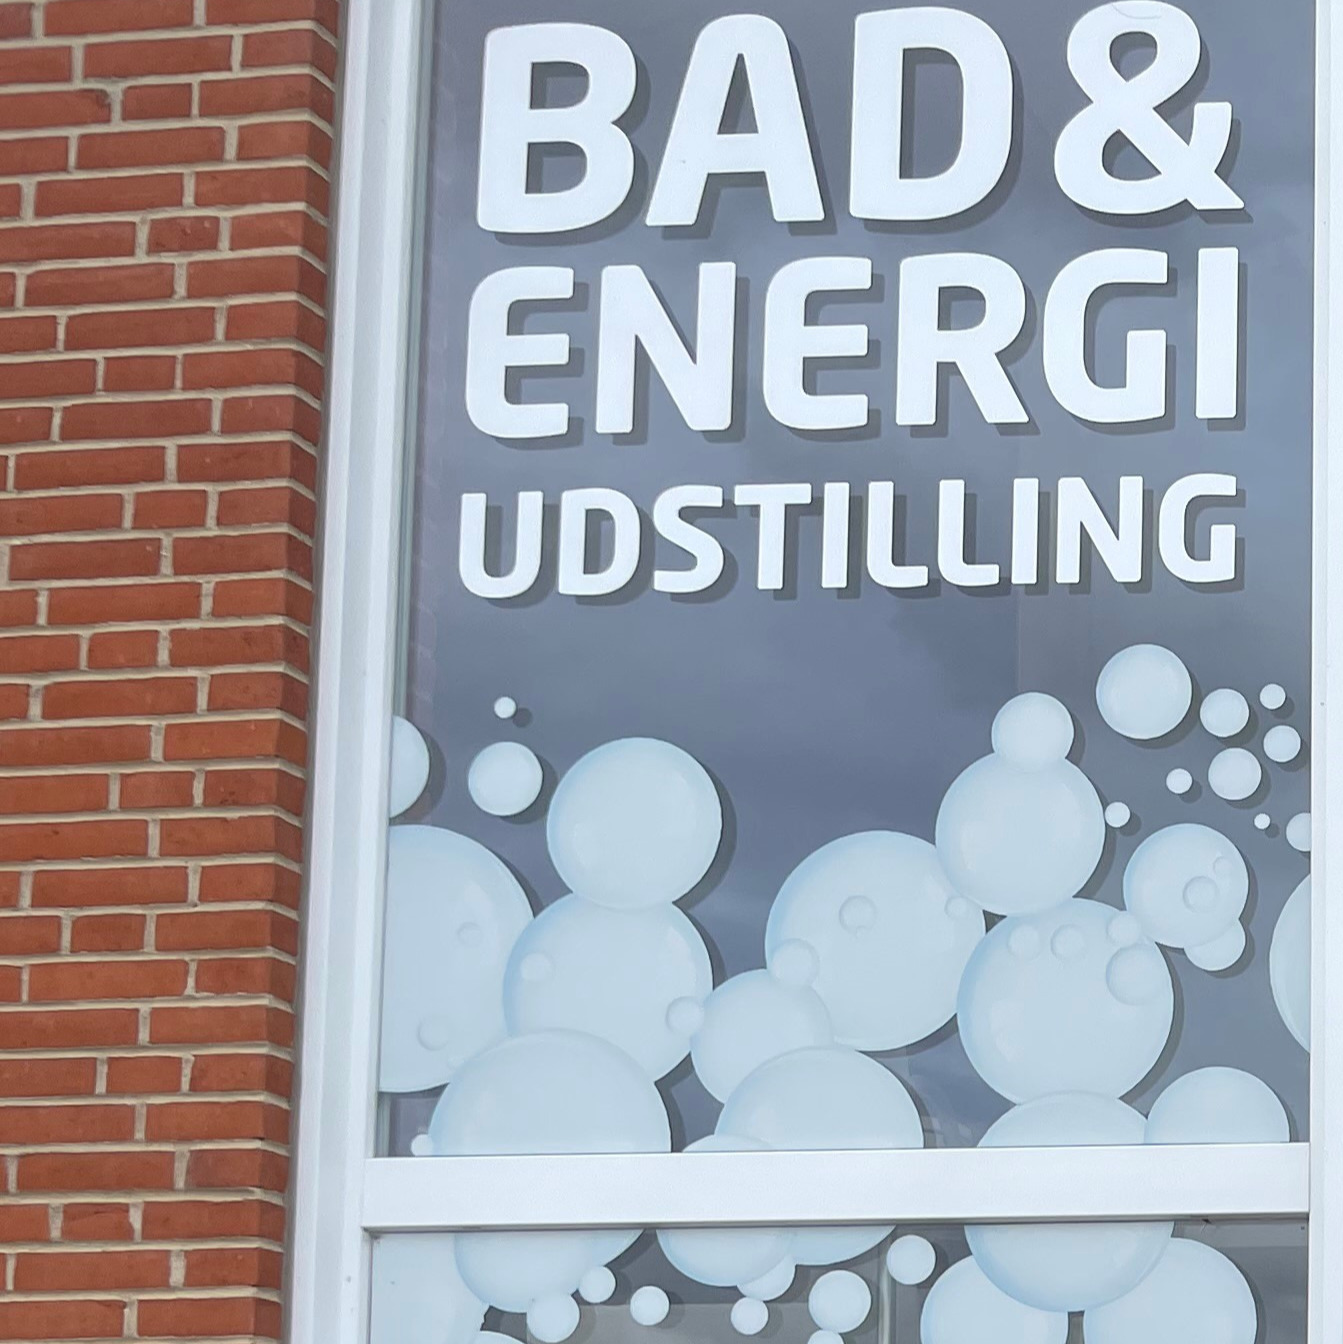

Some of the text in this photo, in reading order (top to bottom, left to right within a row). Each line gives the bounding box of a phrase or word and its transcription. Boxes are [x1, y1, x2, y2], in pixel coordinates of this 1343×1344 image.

[475, 0, 1246, 234] BAD &
[464, 247, 1240, 439] ENERGI
[458, 472, 1238, 599] UDSTILLING
